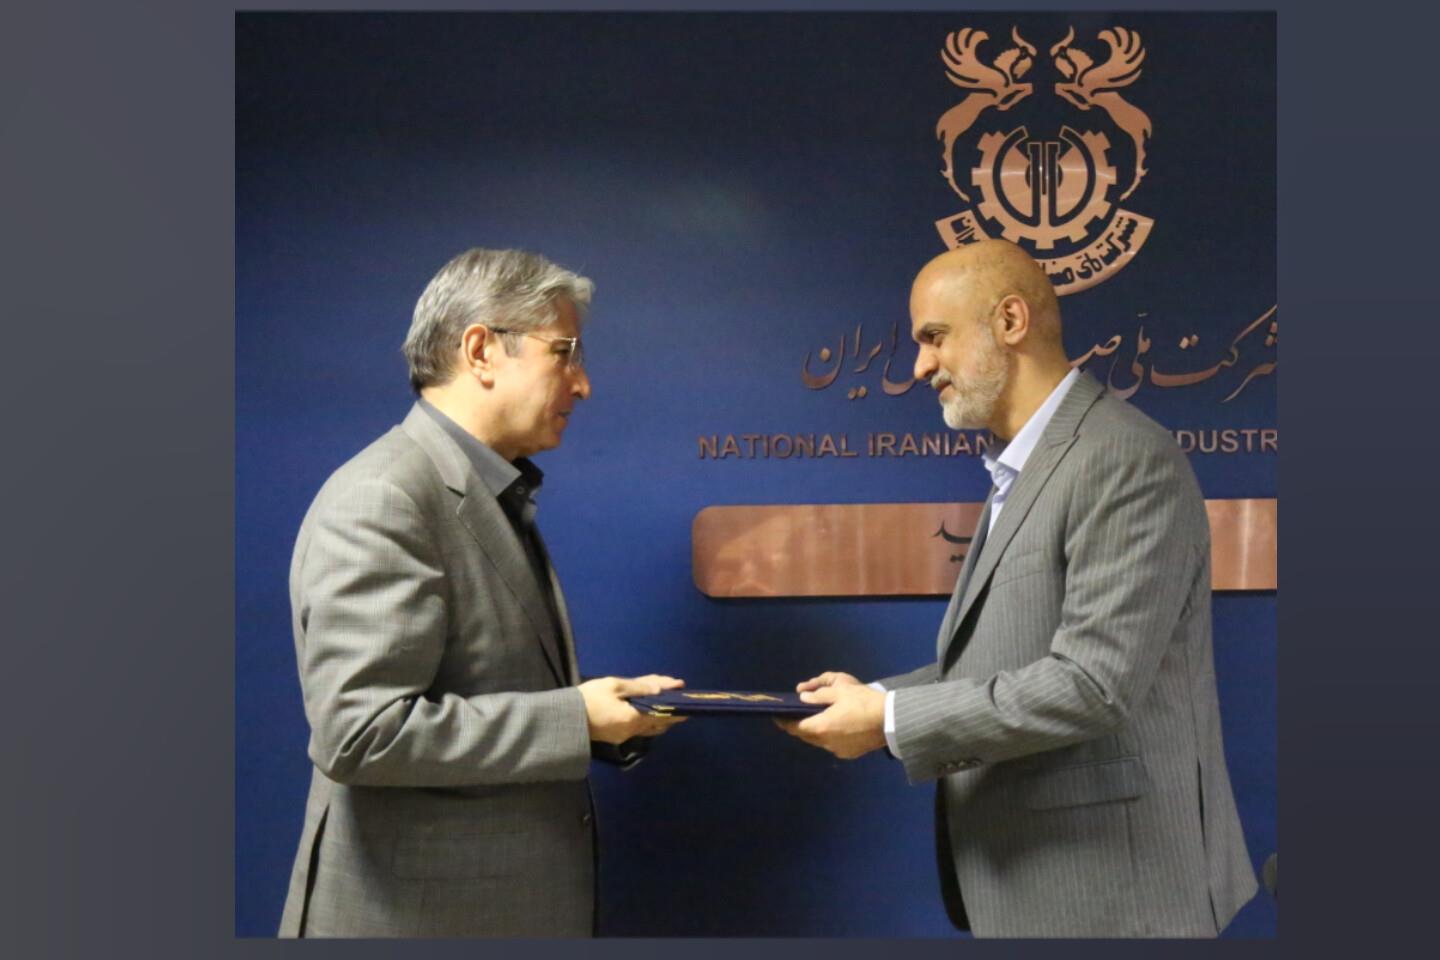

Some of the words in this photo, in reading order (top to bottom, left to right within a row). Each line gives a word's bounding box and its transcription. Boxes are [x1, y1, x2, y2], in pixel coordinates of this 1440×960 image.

[800, 321, 898, 400] ایران
[696, 432, 858, 459] NATIONAL
[867, 431, 996, 457] IRANIAN
[1177, 429, 1278, 453] DUSTR
